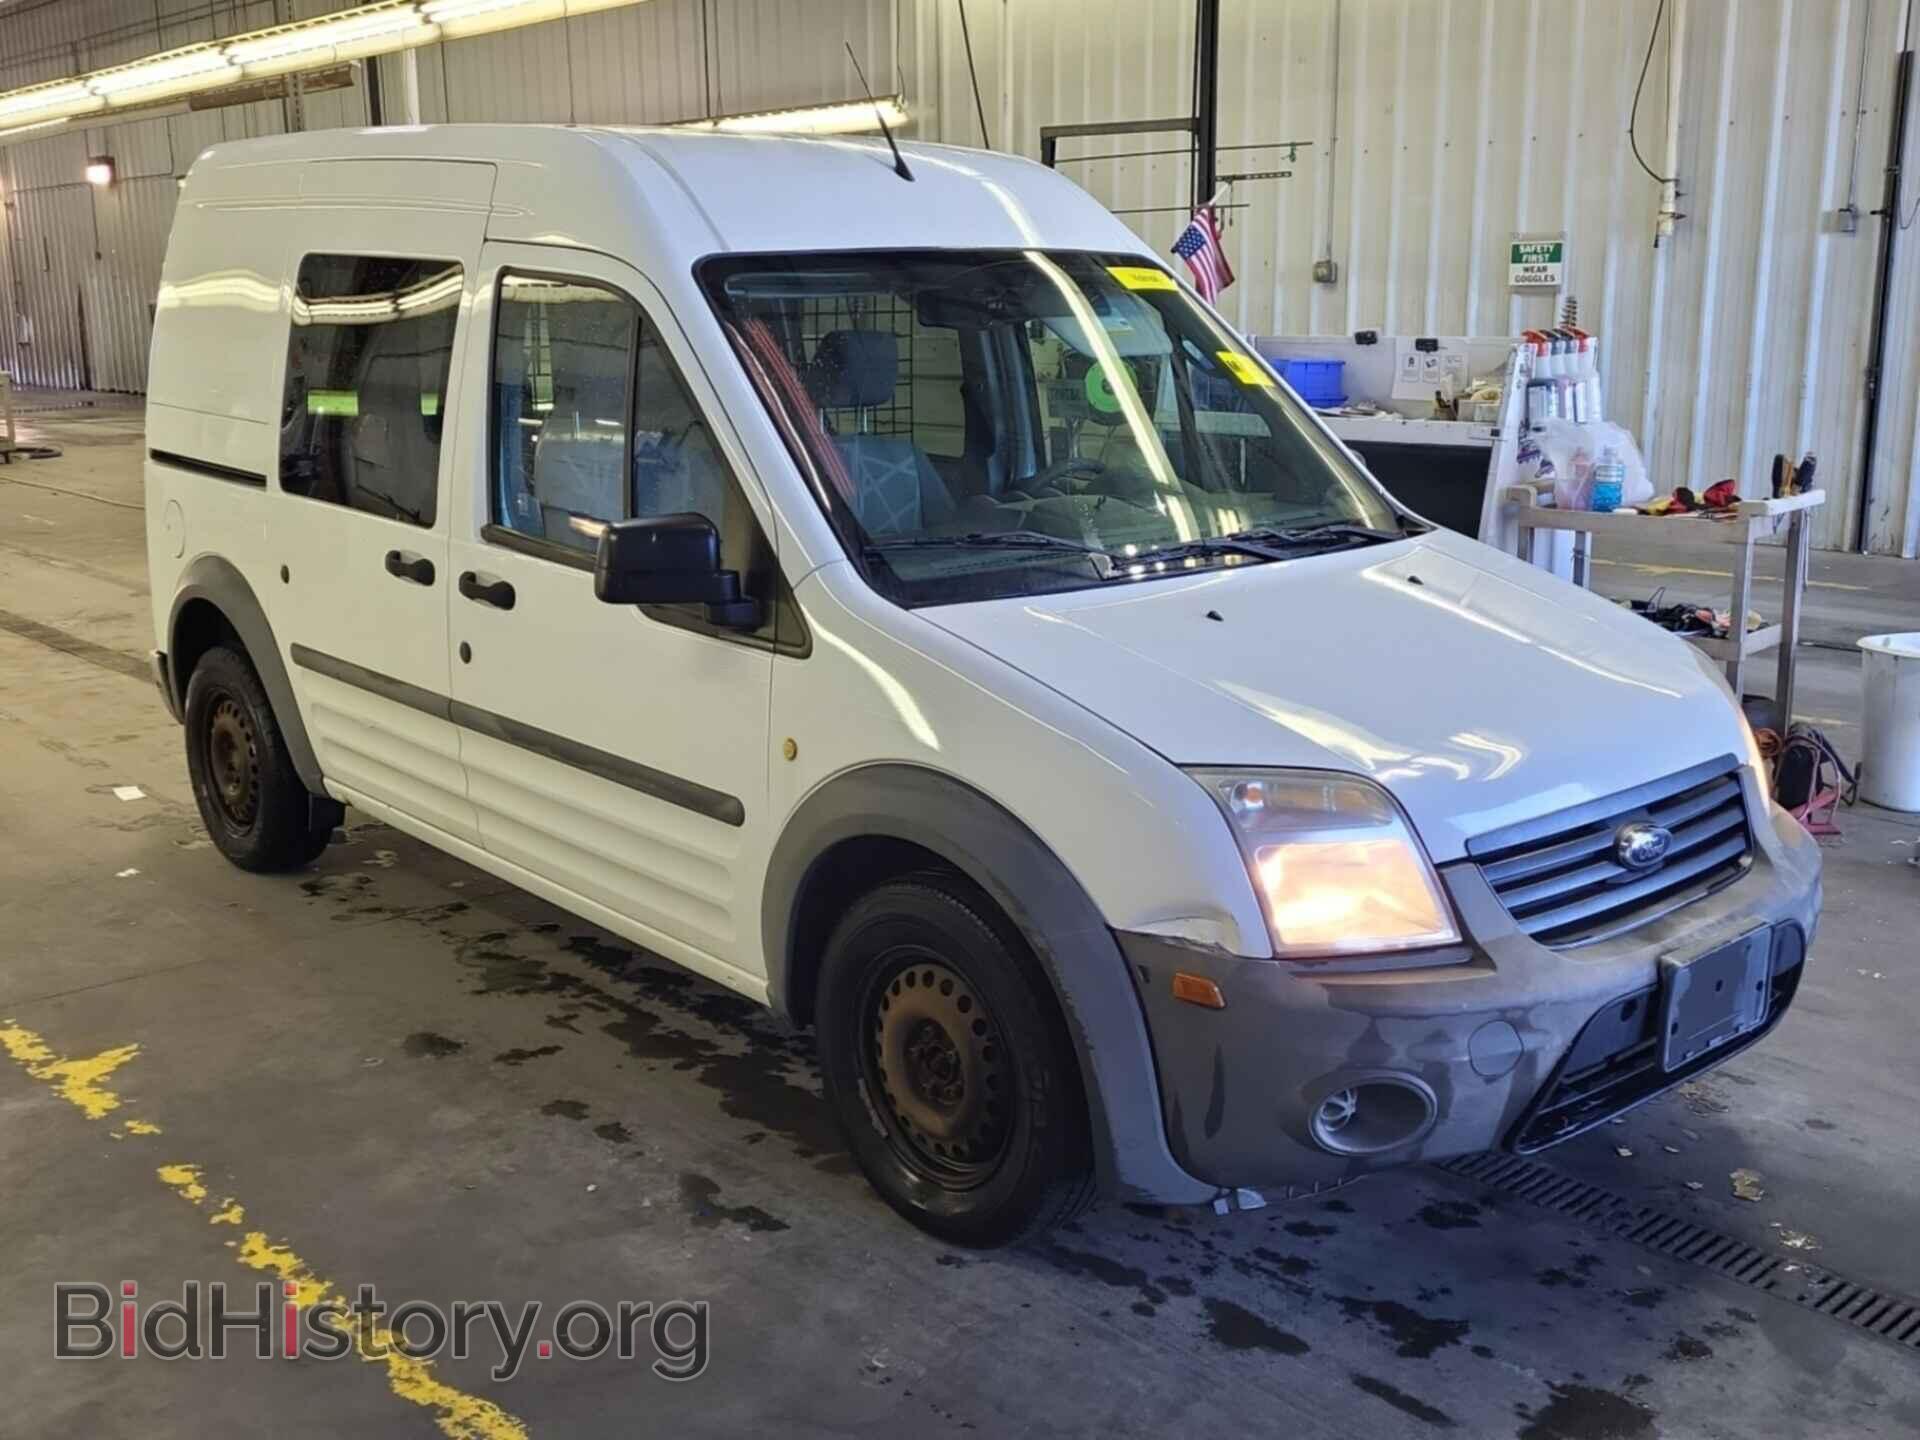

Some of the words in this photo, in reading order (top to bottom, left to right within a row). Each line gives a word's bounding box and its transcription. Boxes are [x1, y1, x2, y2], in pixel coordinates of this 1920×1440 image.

[1519, 244, 1554, 253] SAFETY
[1522, 253, 1550, 262] FIRST
[1514, 274, 1555, 282] GOGGLES
